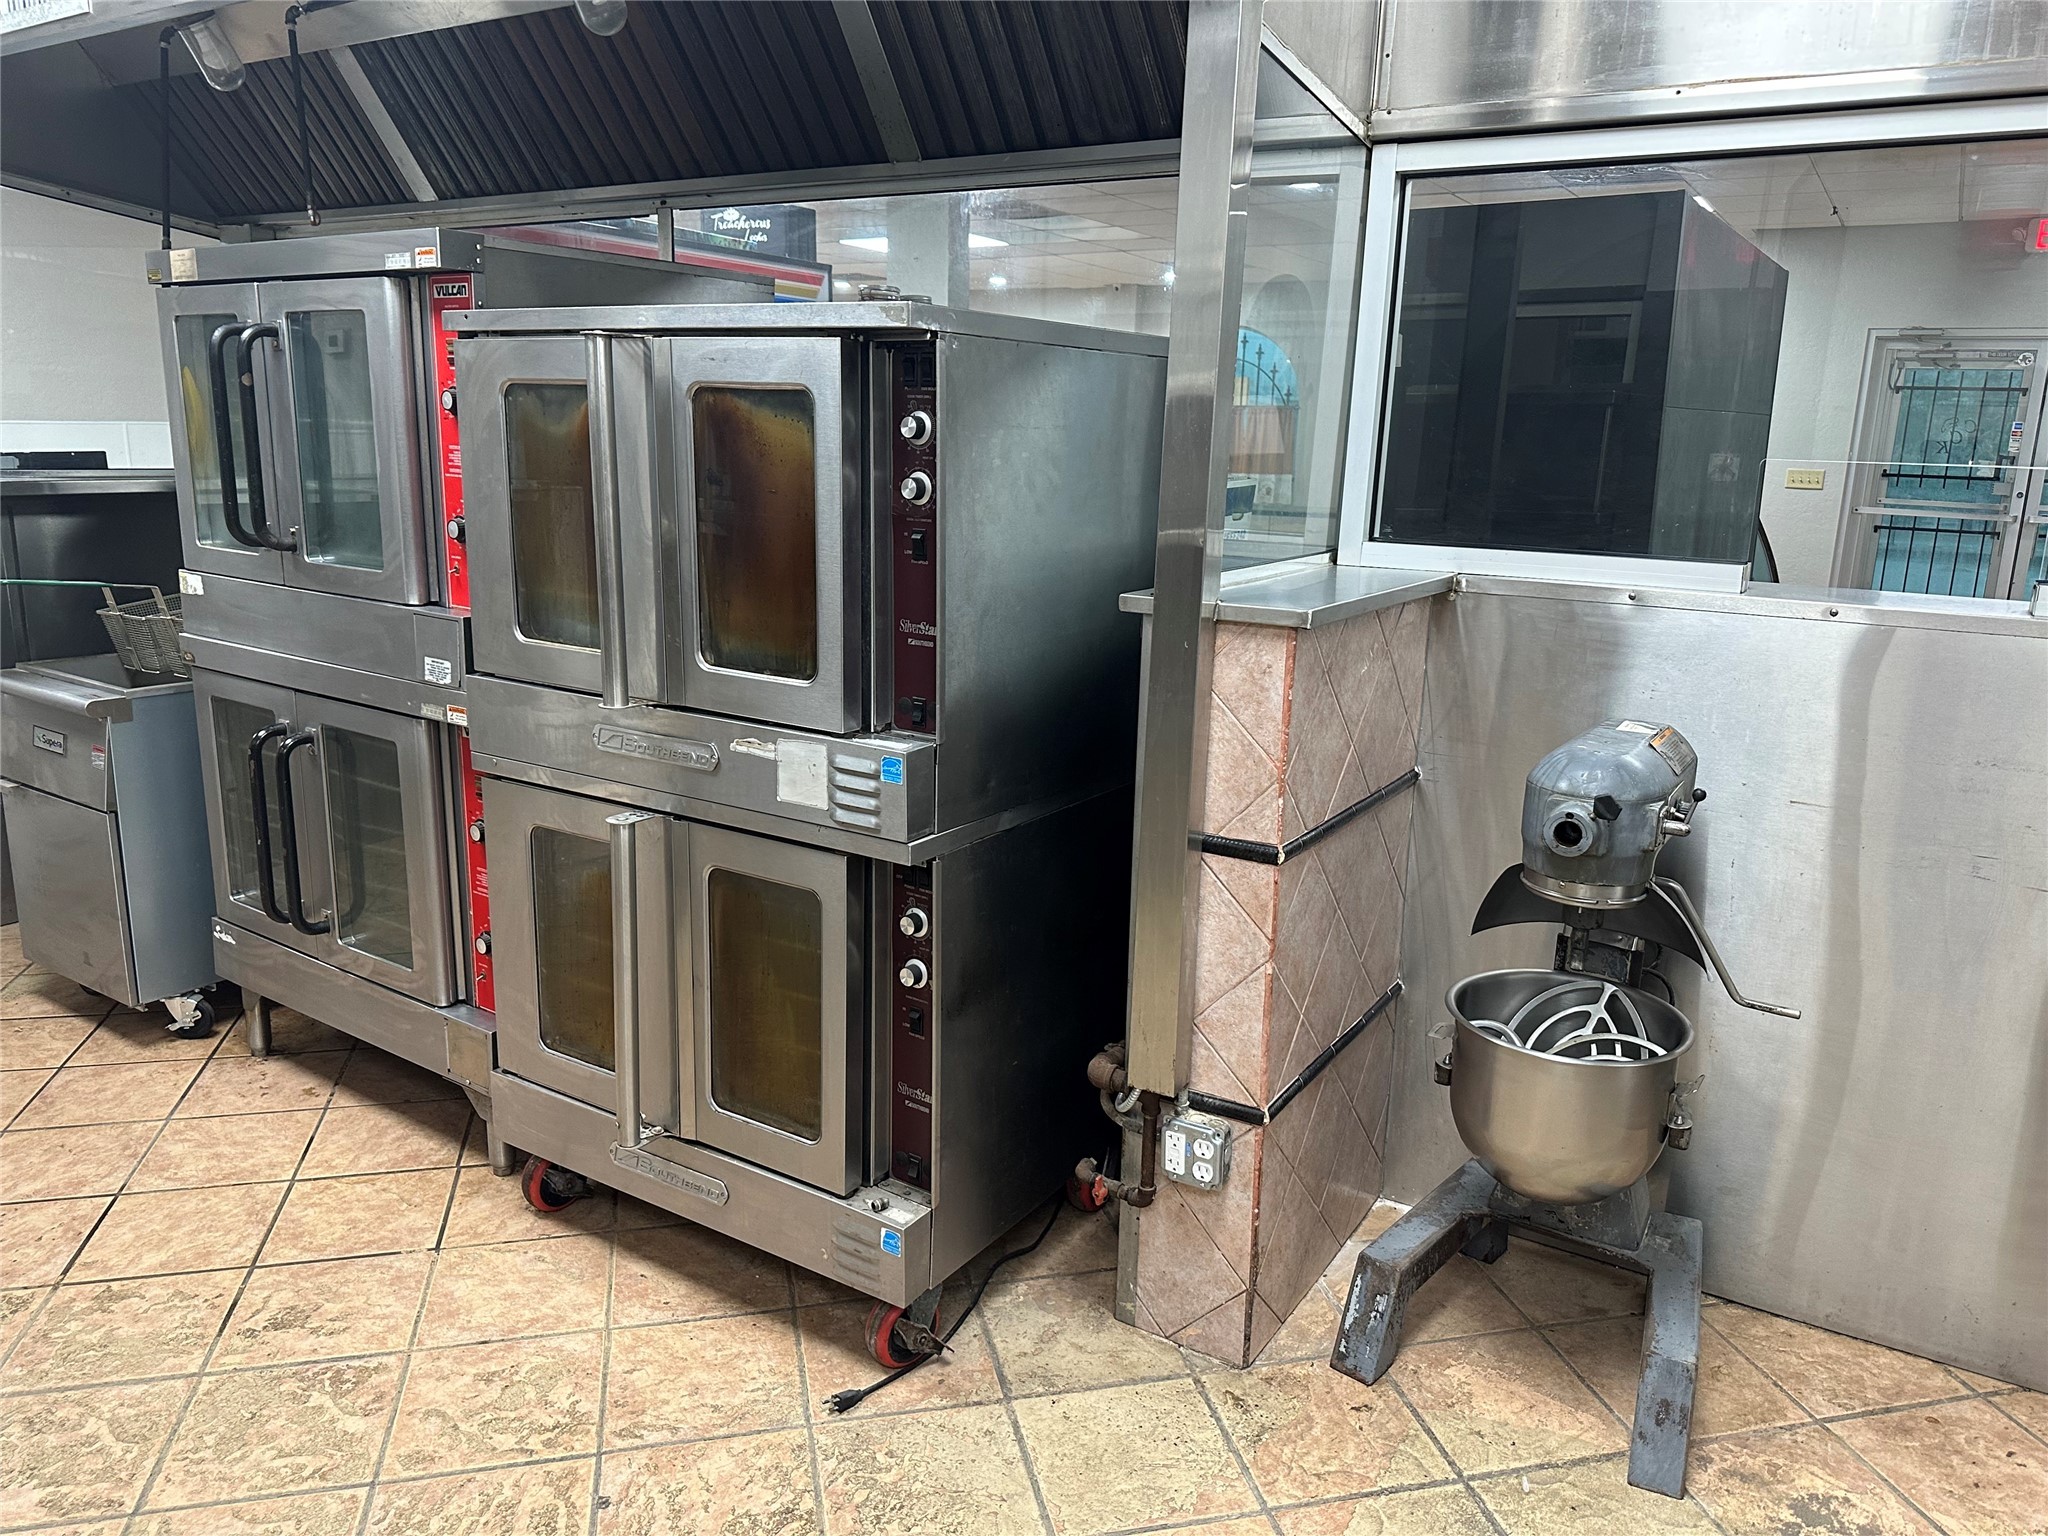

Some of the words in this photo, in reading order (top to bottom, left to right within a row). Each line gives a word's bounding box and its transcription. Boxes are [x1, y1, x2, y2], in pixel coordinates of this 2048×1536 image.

[711, 212, 771, 231] Treacherous
[435, 284, 468, 297] VULCAN
[41, 734, 62, 748] Supera
[624, 736, 710, 765] SOUTHBEND
